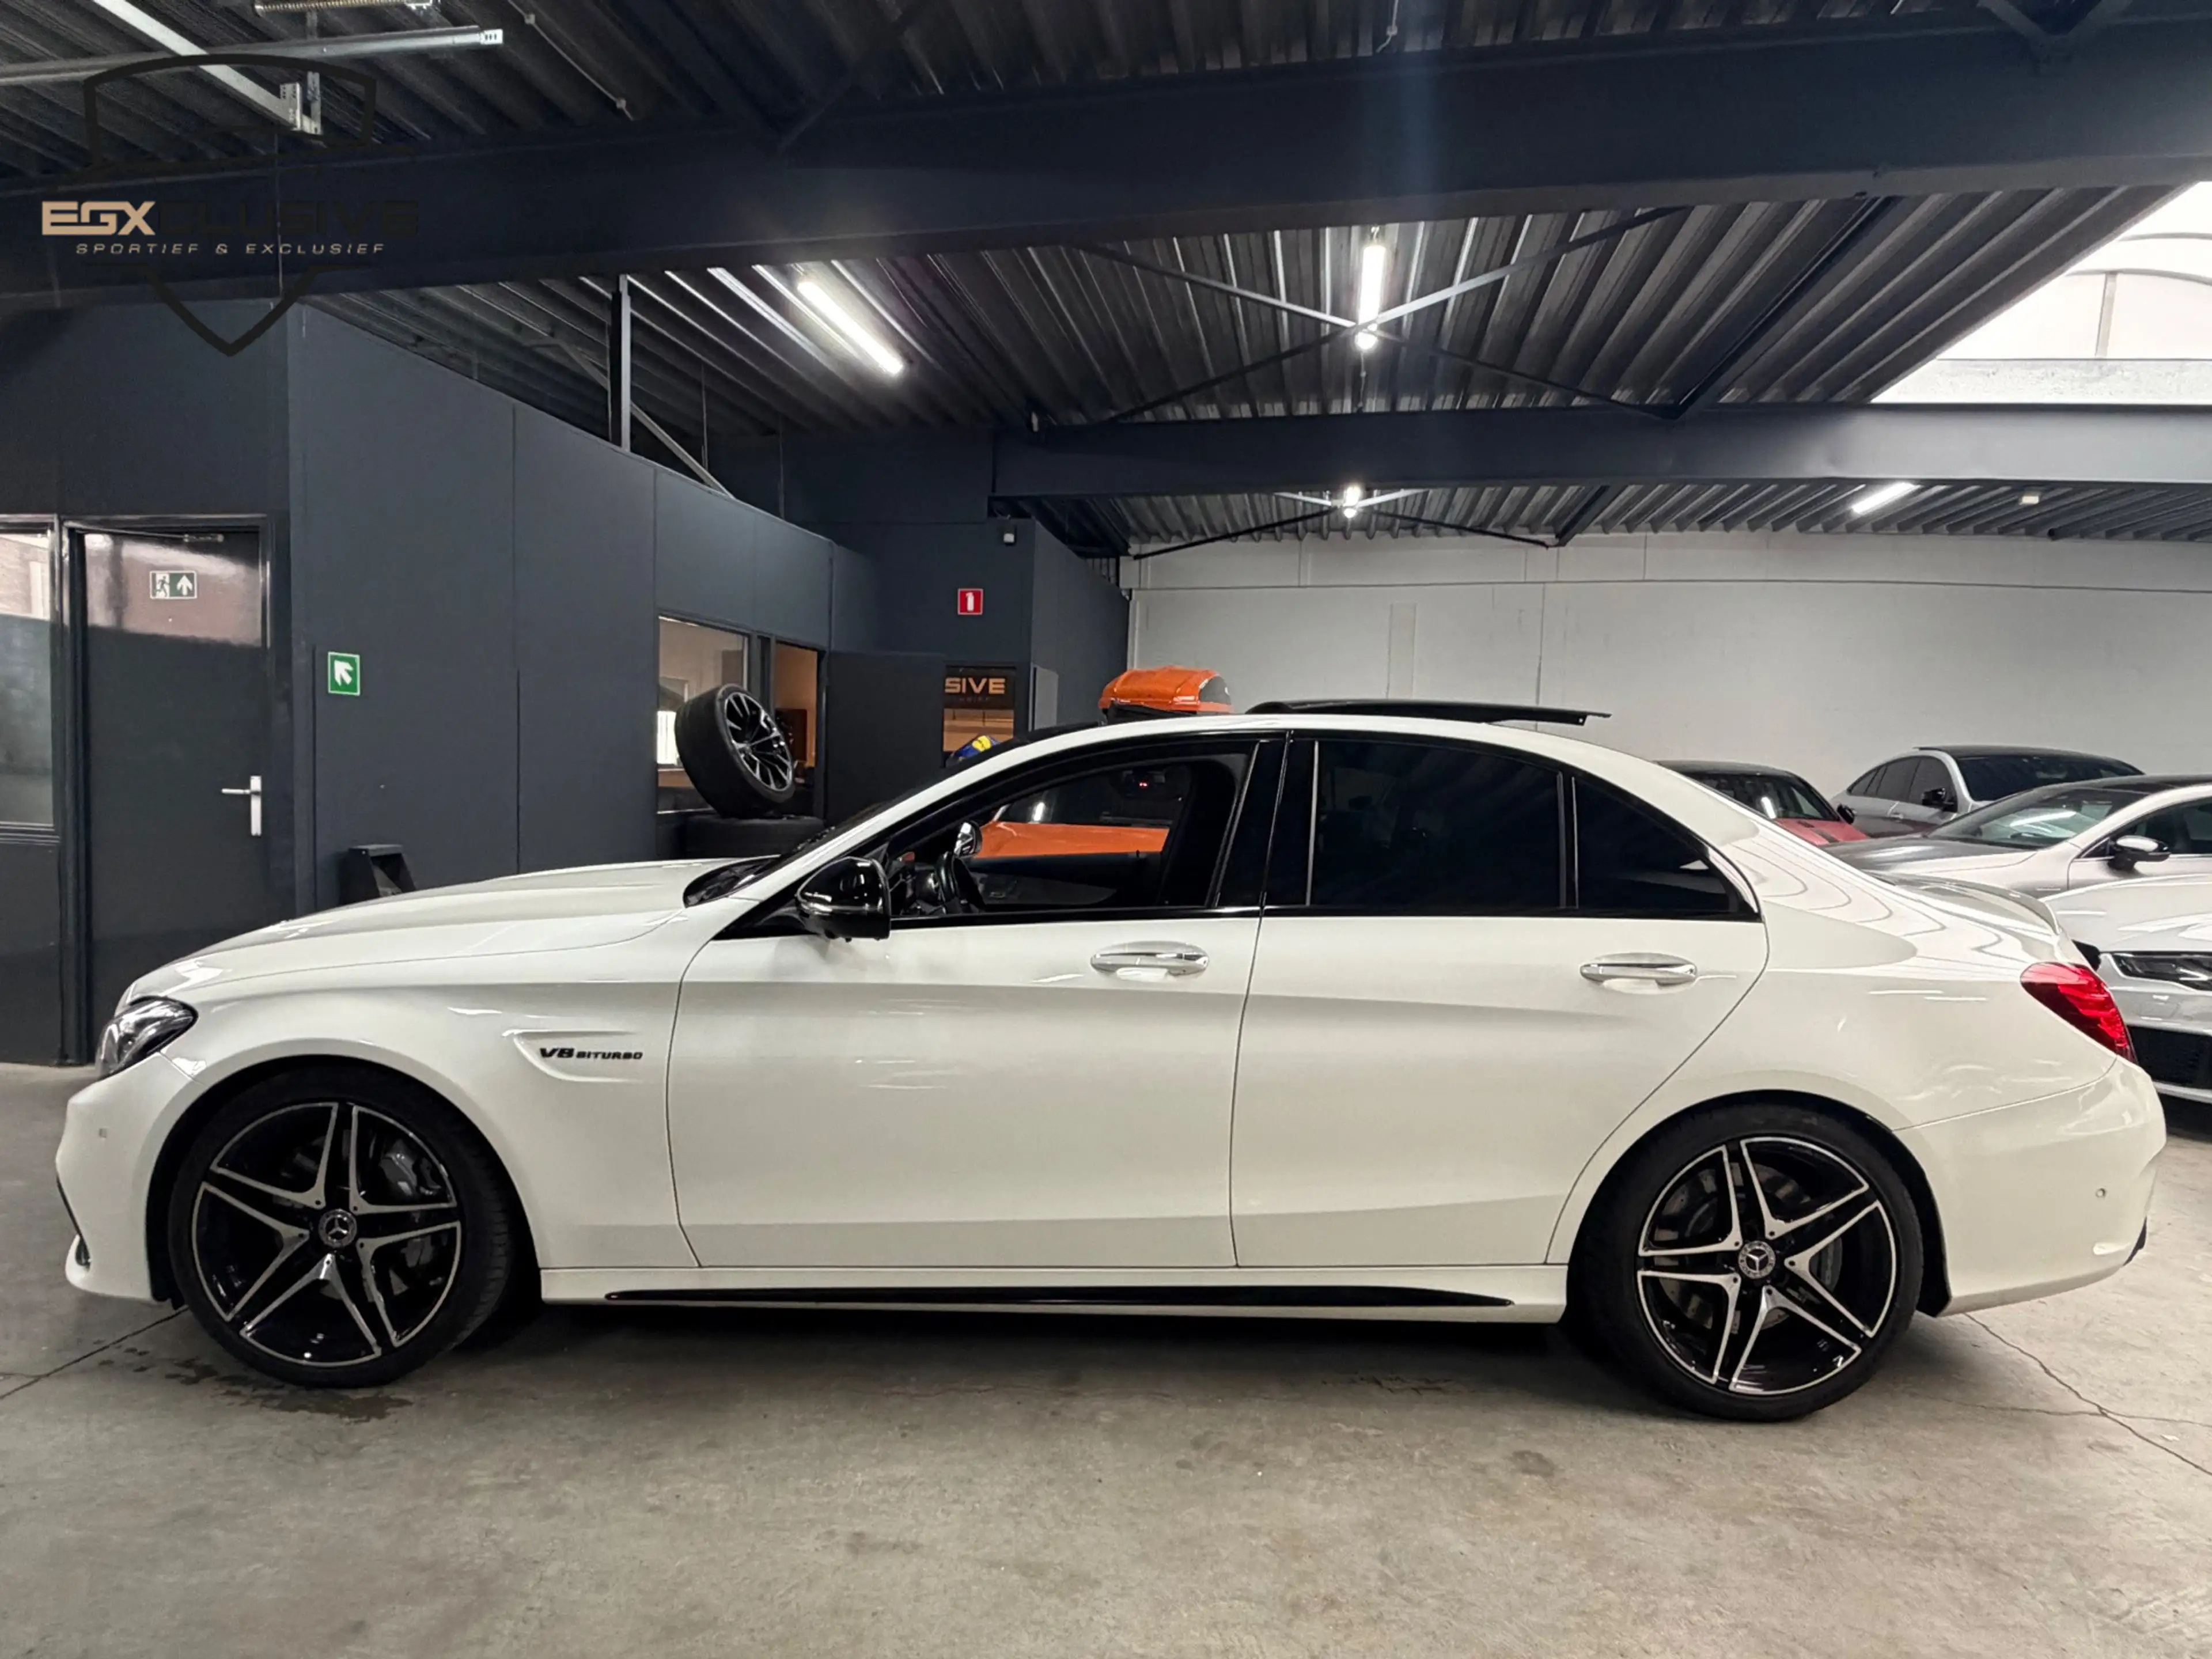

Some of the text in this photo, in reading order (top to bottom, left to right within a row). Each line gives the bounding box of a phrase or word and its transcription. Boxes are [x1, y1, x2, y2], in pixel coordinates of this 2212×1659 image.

[945, 677, 1005, 694] SIVE
[540, 1048, 643, 1059] V8 BITURBO
